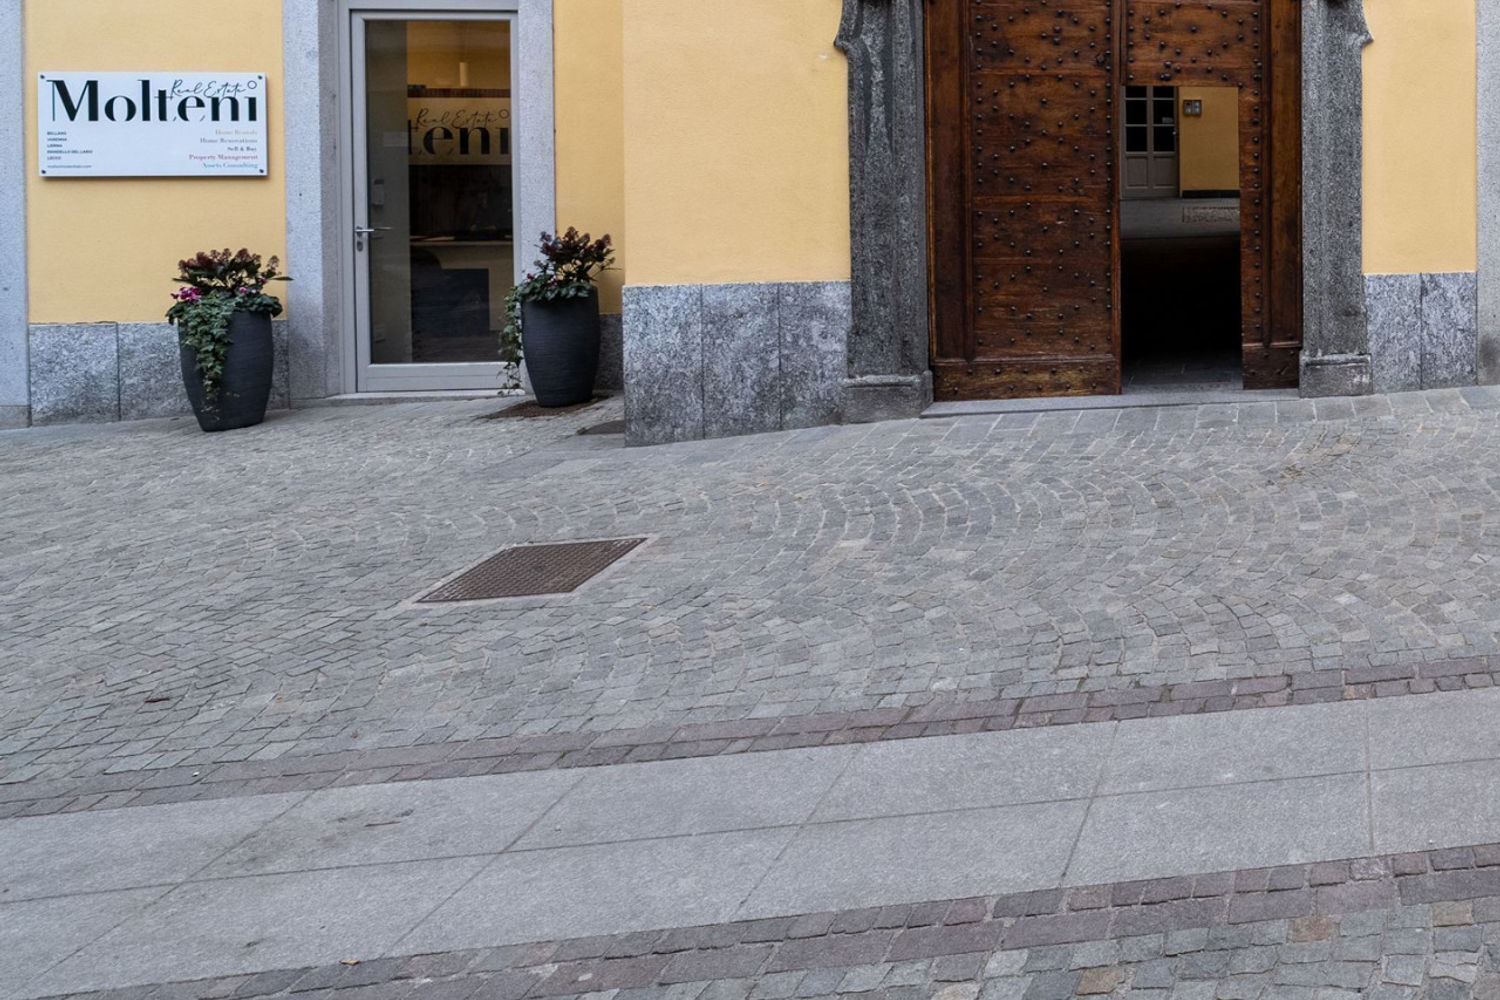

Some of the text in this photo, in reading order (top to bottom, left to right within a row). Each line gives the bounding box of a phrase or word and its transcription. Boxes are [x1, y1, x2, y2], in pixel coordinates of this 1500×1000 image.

[46, 79, 257, 122] Molteni
[170, 79, 248, 101] Real Estate
[415, 108, 499, 131] Real Estate
